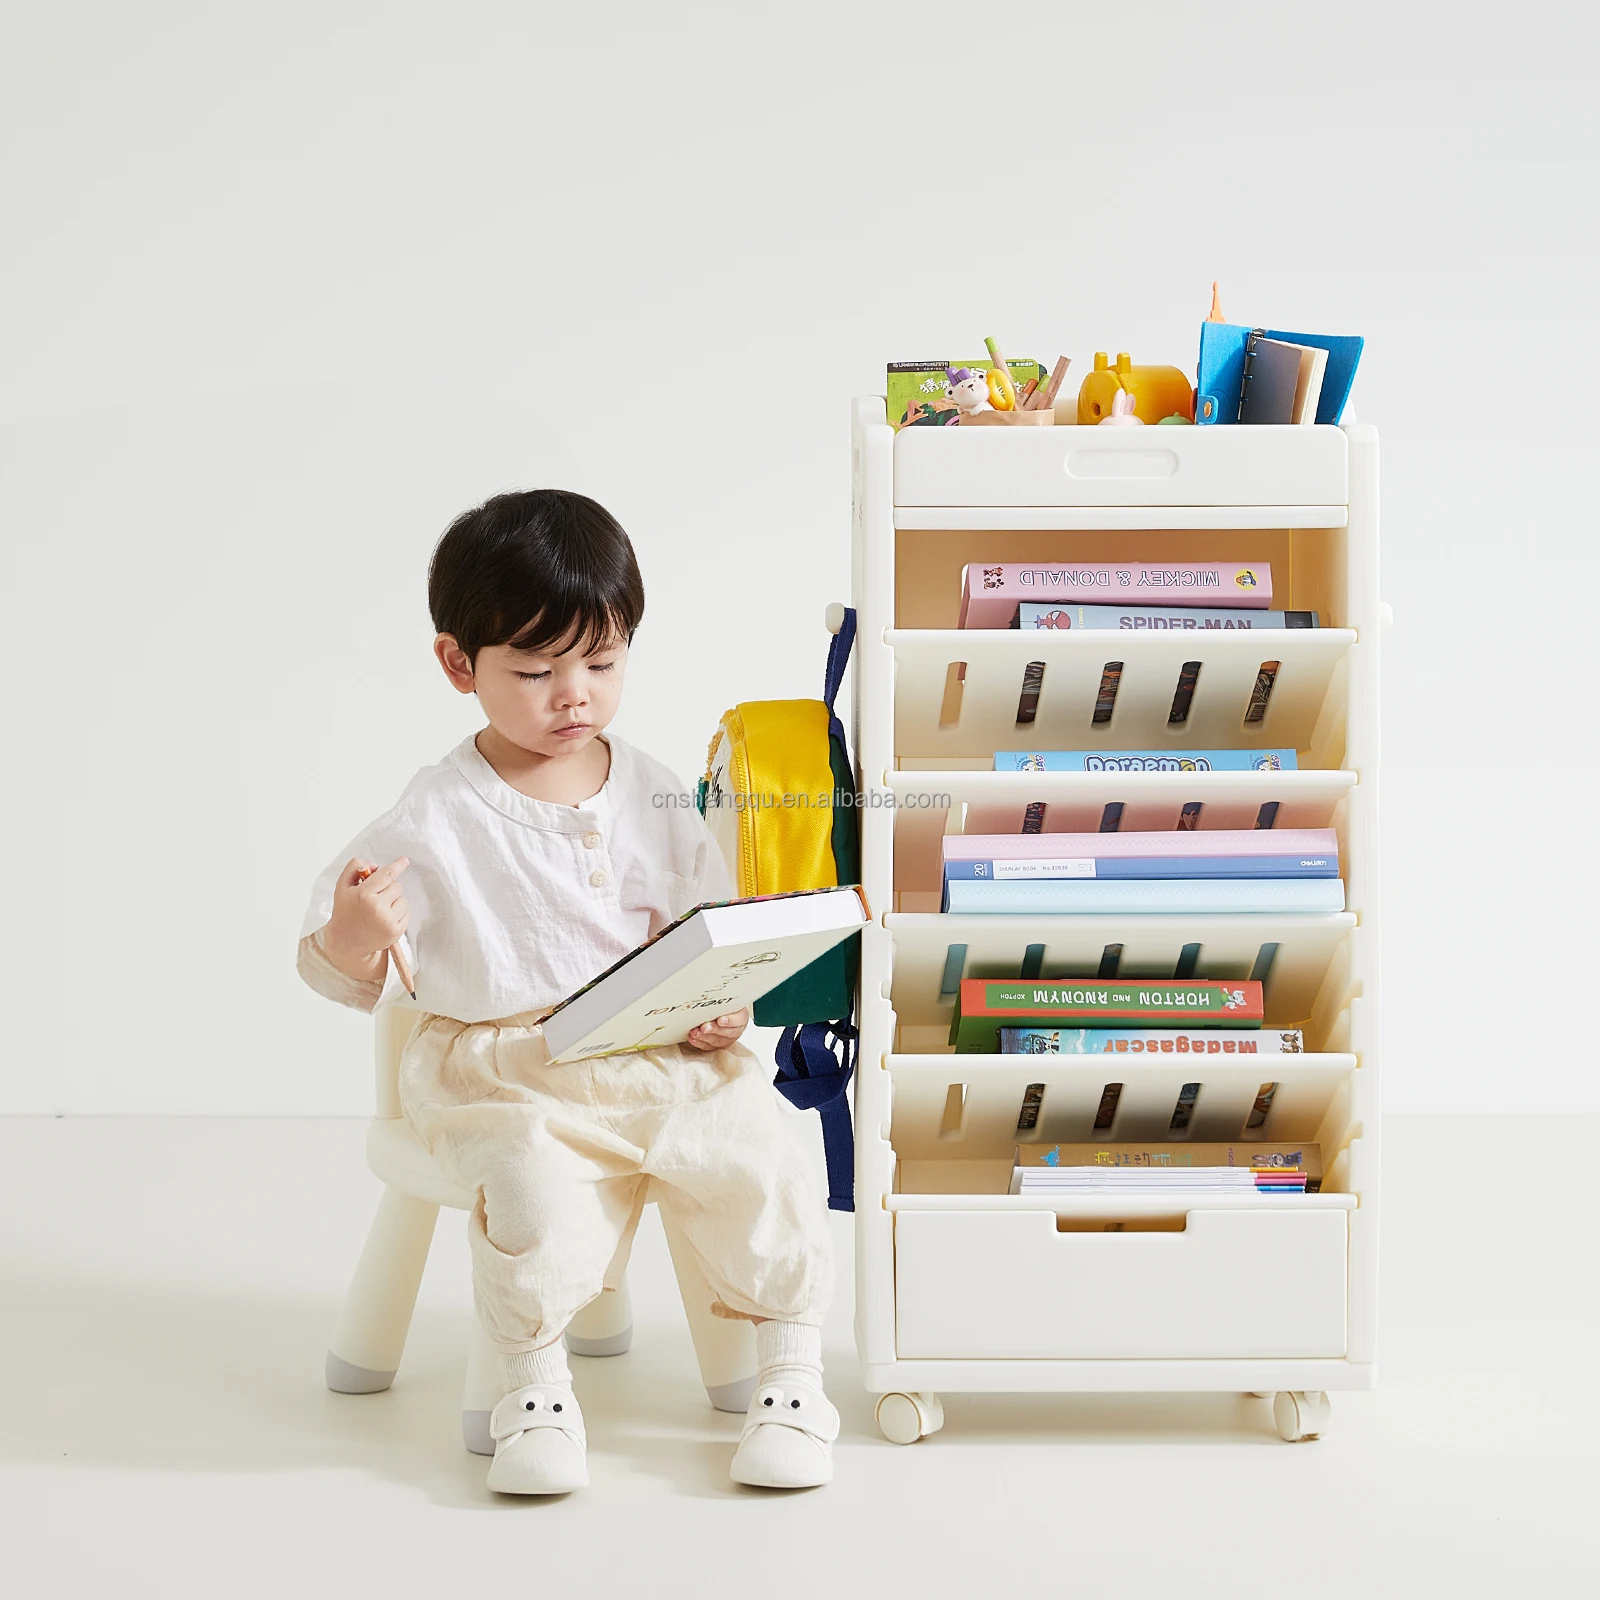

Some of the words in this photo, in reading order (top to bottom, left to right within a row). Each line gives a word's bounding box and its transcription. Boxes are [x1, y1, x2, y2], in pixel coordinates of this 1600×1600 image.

[1019, 570, 1110, 586] DONALD
[1116, 571, 1132, 586] &
[1137, 570, 1219, 586] MICKEY
[1119, 616, 1252, 629] SPIDER-MAN
[1085, 754, 1213, 772] Doraemon
[973, 863, 984, 877] 20
[1033, 990, 1108, 1004] ANONYM
[1112, 994, 1131, 1002] AND
[1139, 992, 1210, 1006] HORTON
[1103, 1036, 1257, 1054] Madagascar
